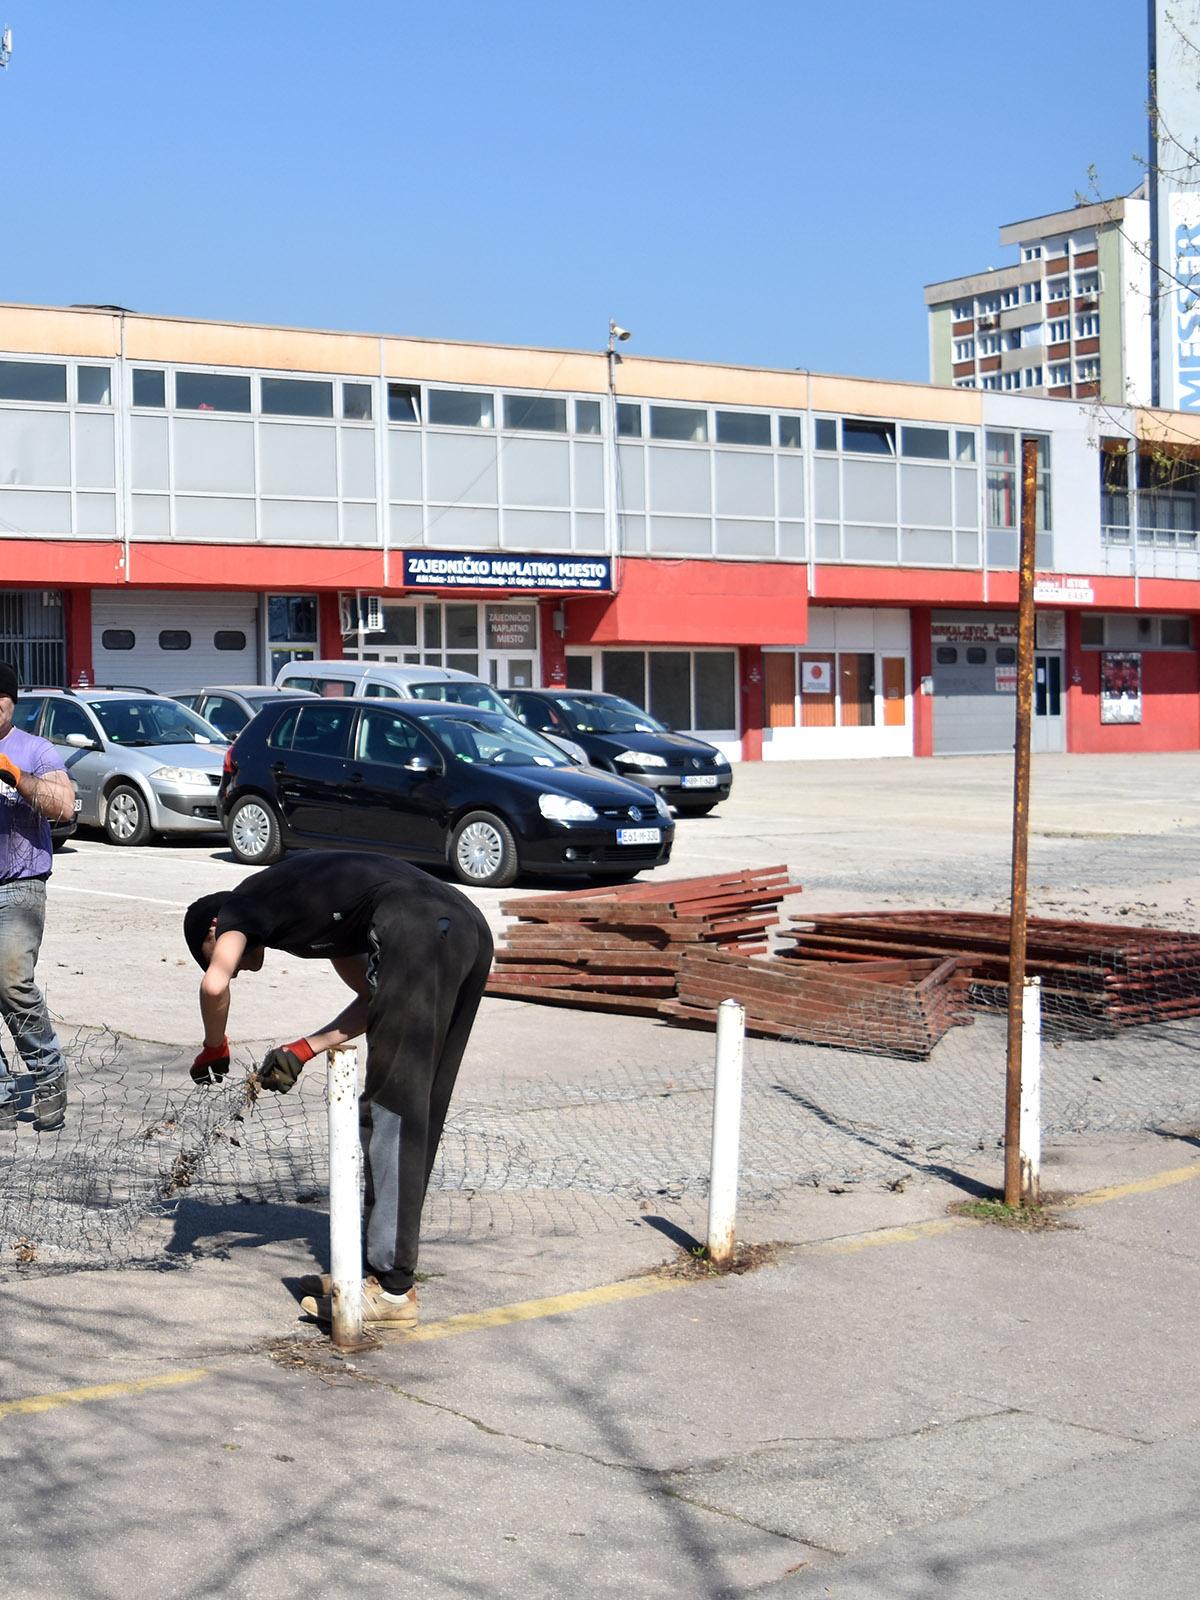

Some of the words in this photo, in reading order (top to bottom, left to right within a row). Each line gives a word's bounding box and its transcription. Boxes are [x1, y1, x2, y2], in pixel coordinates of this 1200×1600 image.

[408, 557, 490, 575] ZAJEDNIČKO
[491, 561, 557, 577] NAPLATNO
[558, 563, 606, 578] MJESTO
[489, 612, 530, 622] ZAJEDNIČKO
[491, 624, 529, 633] NAPLATNO
[496, 634, 524, 643] MJESTO
